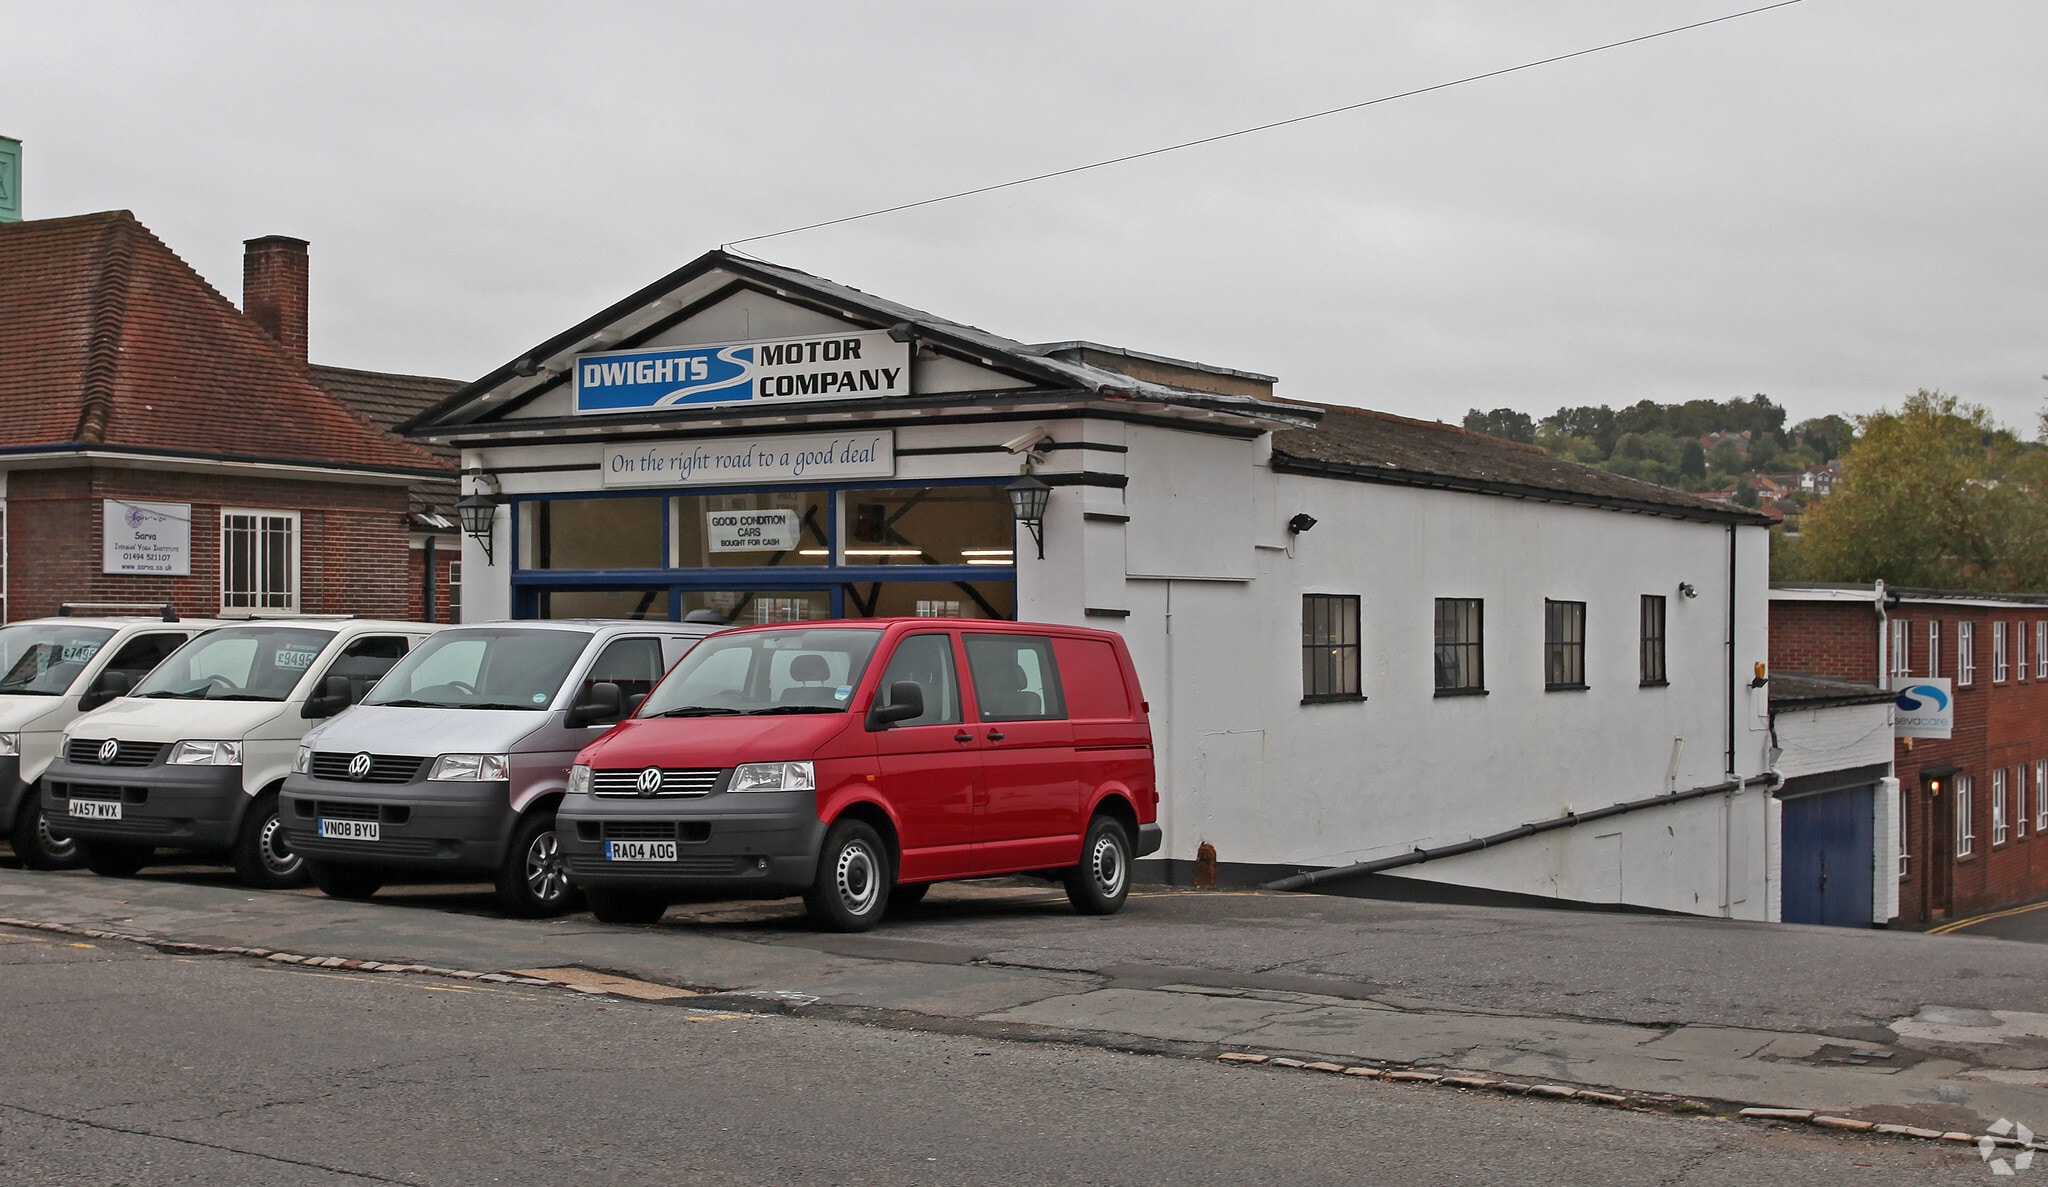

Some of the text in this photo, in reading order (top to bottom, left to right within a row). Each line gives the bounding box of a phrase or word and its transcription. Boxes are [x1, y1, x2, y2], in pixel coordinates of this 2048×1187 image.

[760, 339, 861, 366] MOTOR
[583, 356, 708, 388] DWIGHTS
[759, 367, 902, 398] COMPANY
[611, 438, 880, 481] On the right road to a good deal
[712, 515, 786, 527] GOOD CONDITION
[134, 531, 157, 541] Sarva
[737, 527, 761, 537] CARS
[721, 539, 746, 547] BOUGHT
[762, 538, 780, 546] CASH
[146, 553, 171, 561] 521107
[121, 563, 173, 571] www.sarva.co.uk
[278, 651, 313, 667] £9495
[1894, 716, 1949, 726] sevacare
[73, 802, 117, 817] VA57 WVX
[323, 821, 377, 838] VN08 BYU
[613, 843, 674, 859] RA04 AOG
